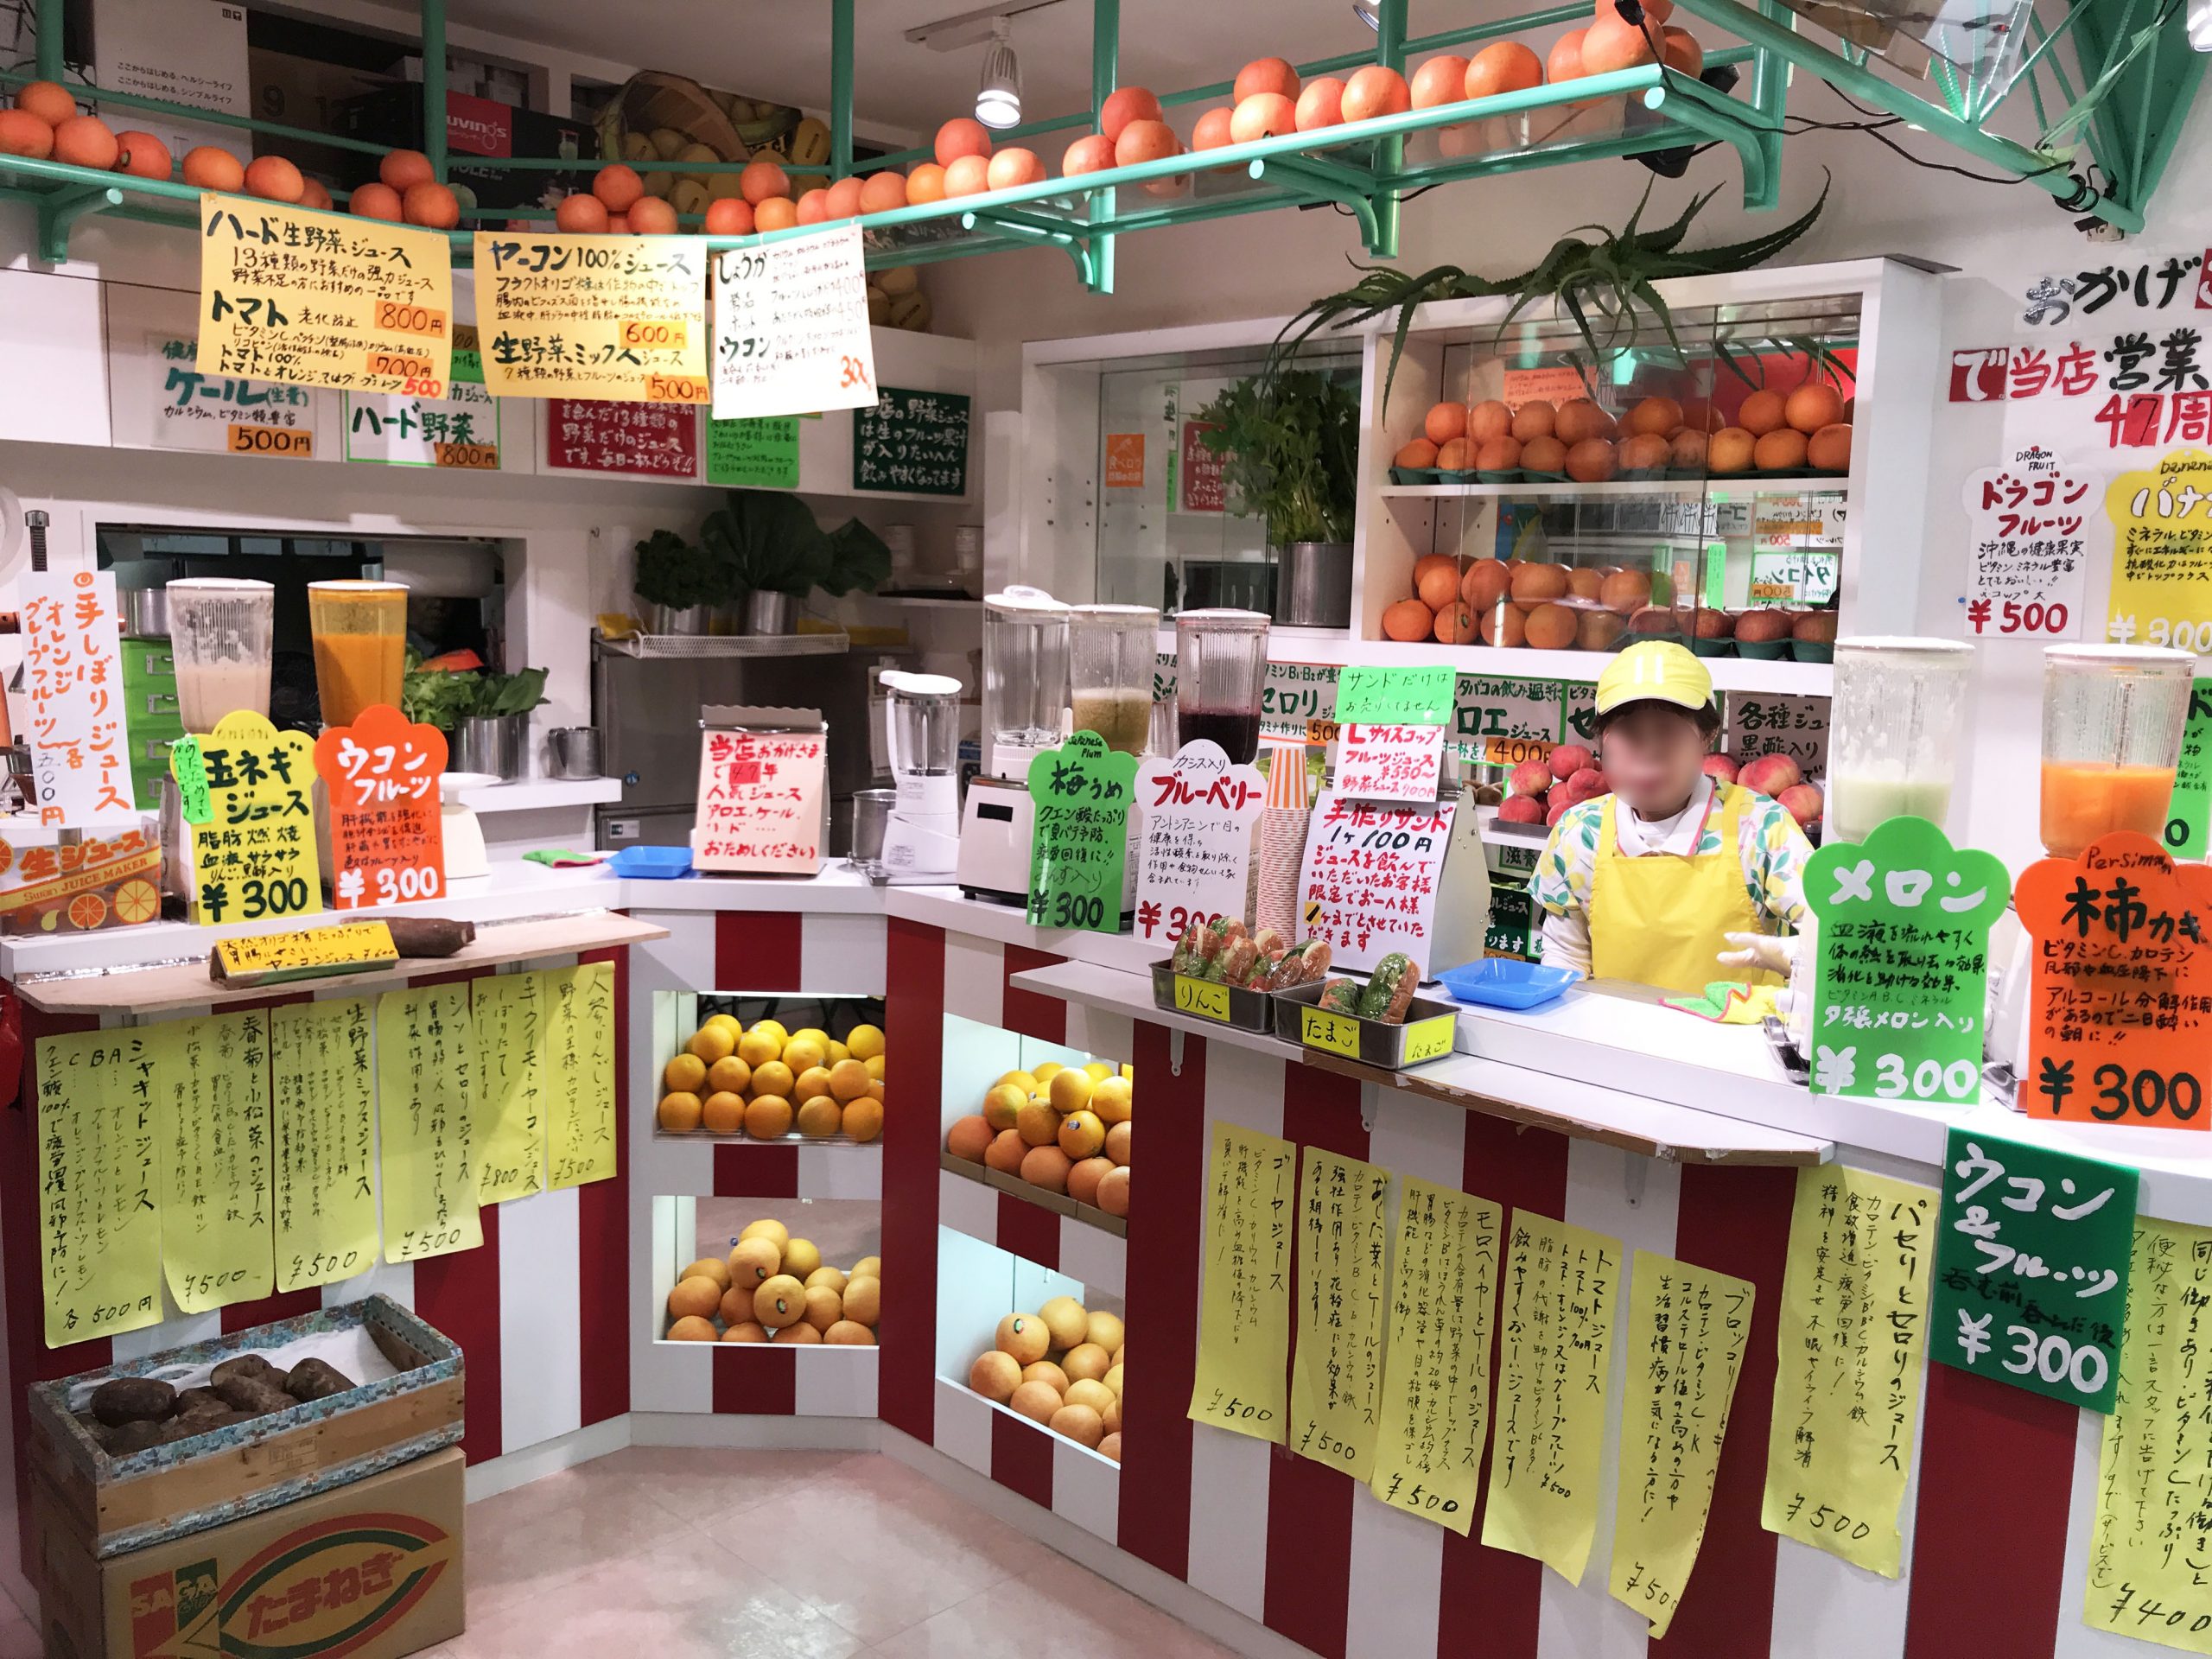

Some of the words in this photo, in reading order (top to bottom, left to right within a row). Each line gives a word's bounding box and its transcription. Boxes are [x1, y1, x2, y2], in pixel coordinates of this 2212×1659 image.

[207, 210, 412, 269] ハード生野菜ジュース
[488, 241, 691, 275] ヤーコン100%ジュース
[719, 249, 770, 284] しょうが
[212, 290, 289, 327] トマト
[298, 307, 359, 328] 老化防止
[381, 302, 443, 334] 800円
[626, 321, 685, 345] 600円
[222, 345, 302, 365] トマト100%
[719, 336, 771, 363] ウコン
[377, 356, 431, 378] 700円
[165, 367, 269, 406] ケール
[402, 377, 442, 398] 500
[652, 377, 709, 400] 500円
[235, 427, 312, 453] 500円
[562, 423, 683, 453] 野菜だけのジュース
[442, 445, 495, 466] 800円
[2016, 450, 2053, 462] DRAGON
[2028, 461, 2056, 472] FRUIT
[1982, 471, 2088, 511] ドラゴン
[1998, 513, 2082, 538] フルーツ
[1978, 540, 2085, 559] 沖縄の健康果実
[1967, 598, 2069, 634] ¥500
[45, 601, 74, 695] オレンジ
[25, 595, 59, 739] グレープフルーツ
[1348, 672, 1448, 691] サンドだけは
[74, 593, 131, 813] 手しぼりジュース
[1510, 721, 1552, 742] ジュース
[336, 738, 428, 772] ウコン
[709, 734, 820, 761] 当店おかげさま
[1081, 748, 1102, 759] Plum
[1345, 750, 1434, 768] フルーツジュース
[1739, 734, 1819, 761] 黒酢入り
[202, 741, 303, 789] 玉ネギ
[1173, 754, 1227, 774] カシス入り
[354, 778, 432, 806] フルーツ
[707, 784, 803, 801] 人気ジュース
[1152, 770, 1262, 810] ブルーベリー
[226, 790, 309, 824] ジュース
[1039, 805, 1125, 826] クエン酸たっぷり
[1323, 798, 1454, 834] 手作りサンド
[198, 825, 302, 849] 脂肪燃焼
[704, 840, 816, 859] おためしください
[19, 830, 147, 882] 生ジュース
[200, 847, 300, 869] 血液サラサラ
[1313, 844, 1436, 874] ジュースを飲んで
[61, 873, 101, 893] JUICE
[103, 858, 149, 879] MAKER
[339, 866, 439, 909] ¥300
[1311, 868, 1432, 894] いただいたお客様
[1827, 859, 1987, 913] メロン
[201, 878, 308, 923] ¥300
[1031, 888, 1104, 929] ¥300
[1308, 884, 1420, 915] 限定でお一人様
[1307, 925, 1371, 953] だきます
[1181, 983, 1229, 1015] りんご
[1306, 1016, 1357, 1047] たまご
[1822, 1005, 1974, 1034] 夕張メロン入り
[1411, 1039, 1446, 1059] たまご
[1815, 1045, 1979, 1098] ¥300
[2039, 1056, 2202, 1122] ¥300
[1955, 1141, 2116, 1221] ウコン
[1974, 1238, 2119, 1298] フルーツ
[1586, 1249, 1613, 1394] トマトジュース
[1957, 1308, 2109, 1394] ¥300
[1787, 1492, 1871, 1540] ¥500
[247, 1551, 404, 1640] たまねぎ
